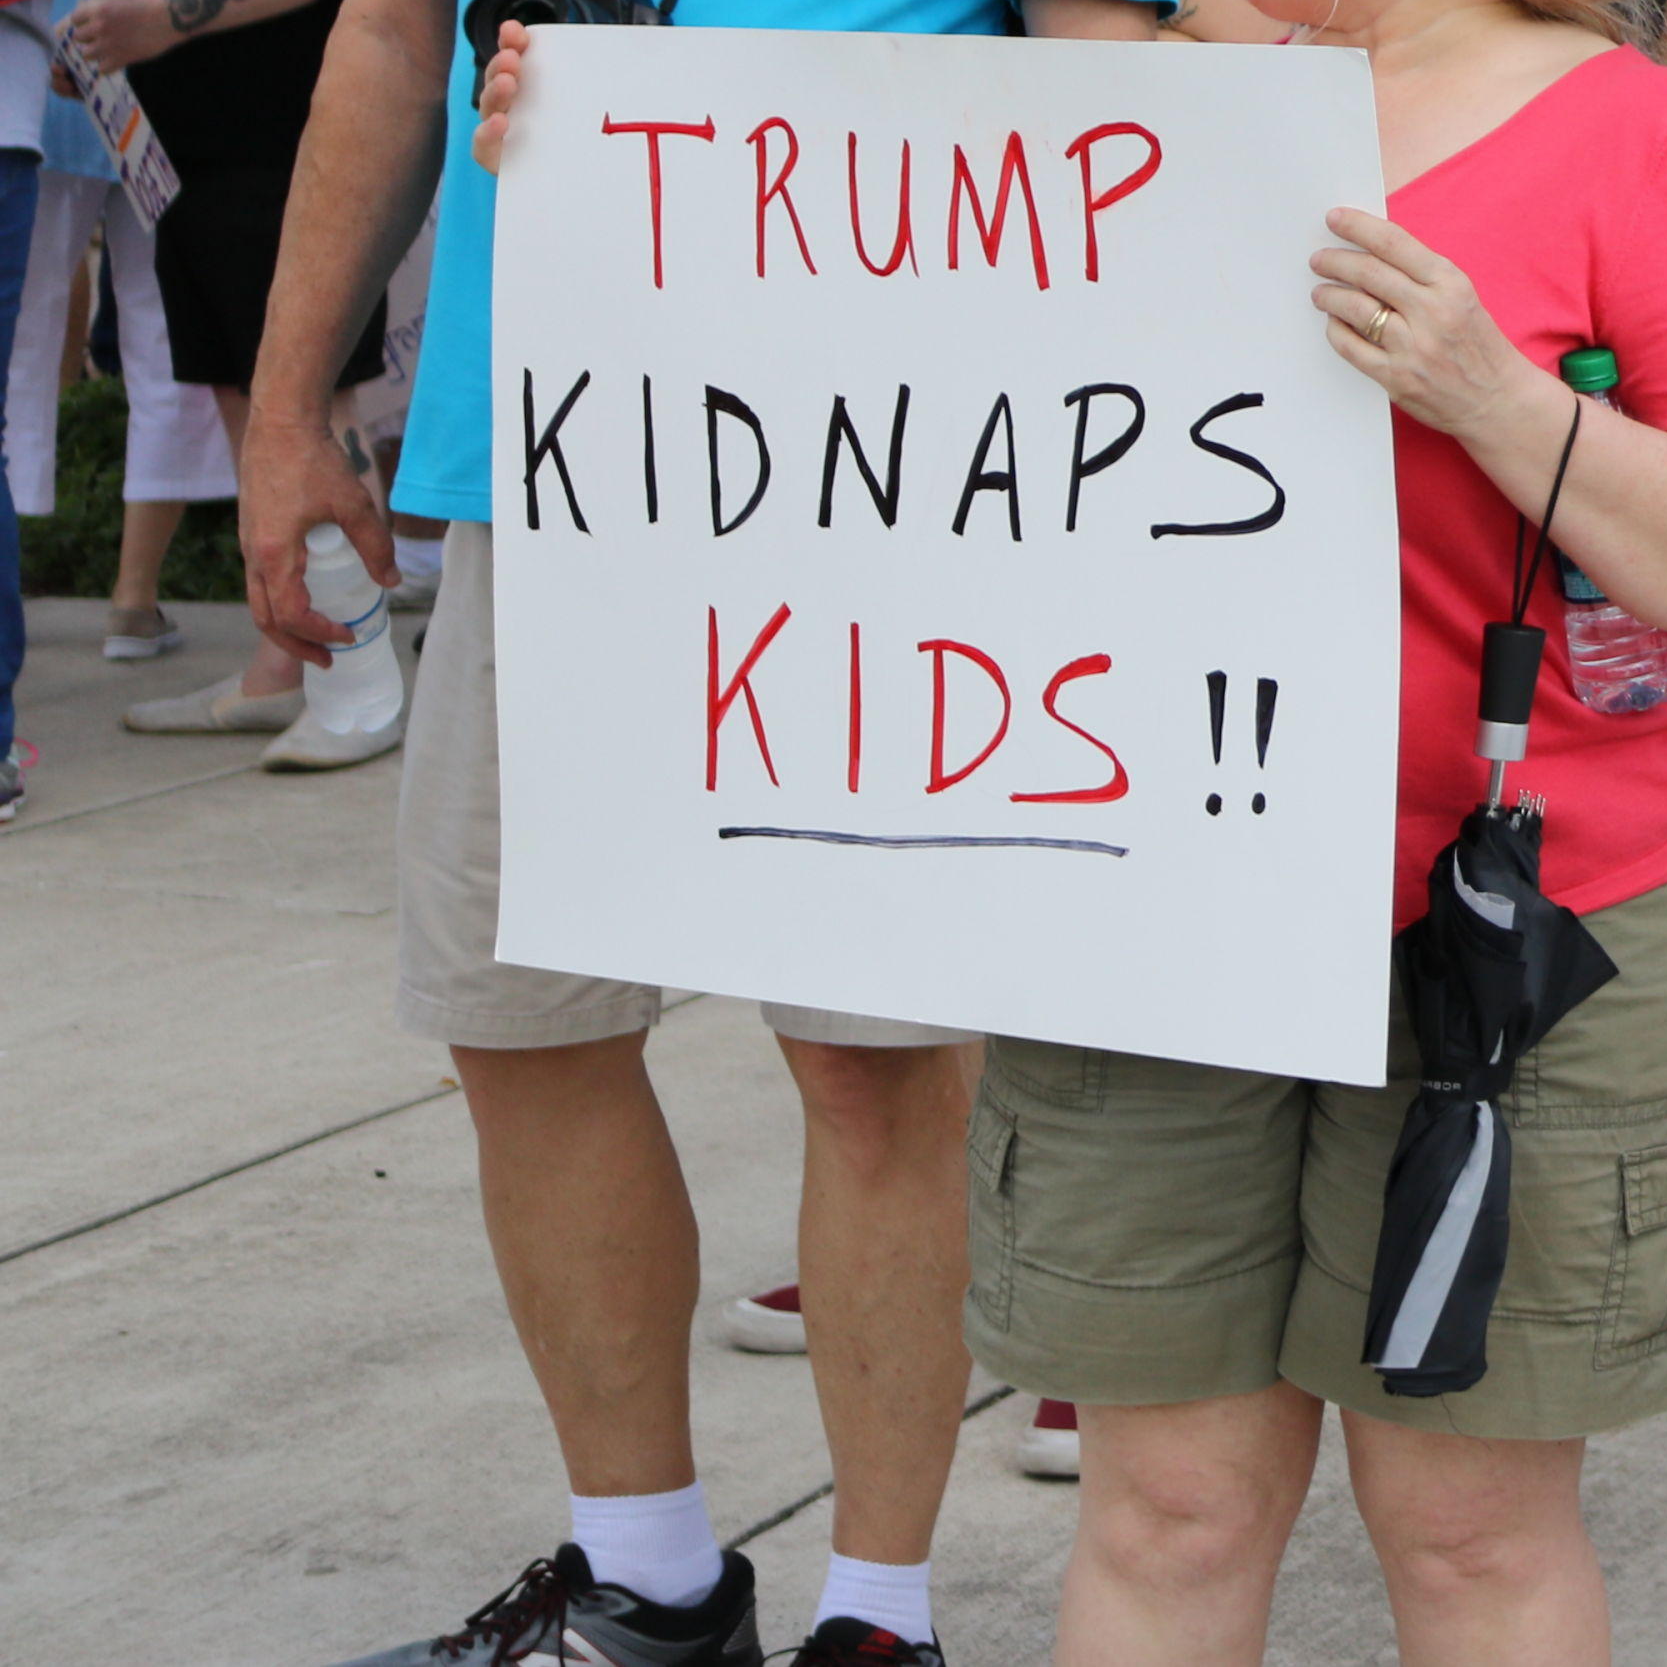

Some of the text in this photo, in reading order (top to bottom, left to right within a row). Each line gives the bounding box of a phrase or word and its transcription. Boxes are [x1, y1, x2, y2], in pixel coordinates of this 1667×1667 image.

[602, 113, 1162, 291] TRUMP
[522, 367, 1286, 542] KIDNAPS
[706, 602, 1130, 802] KIDS
